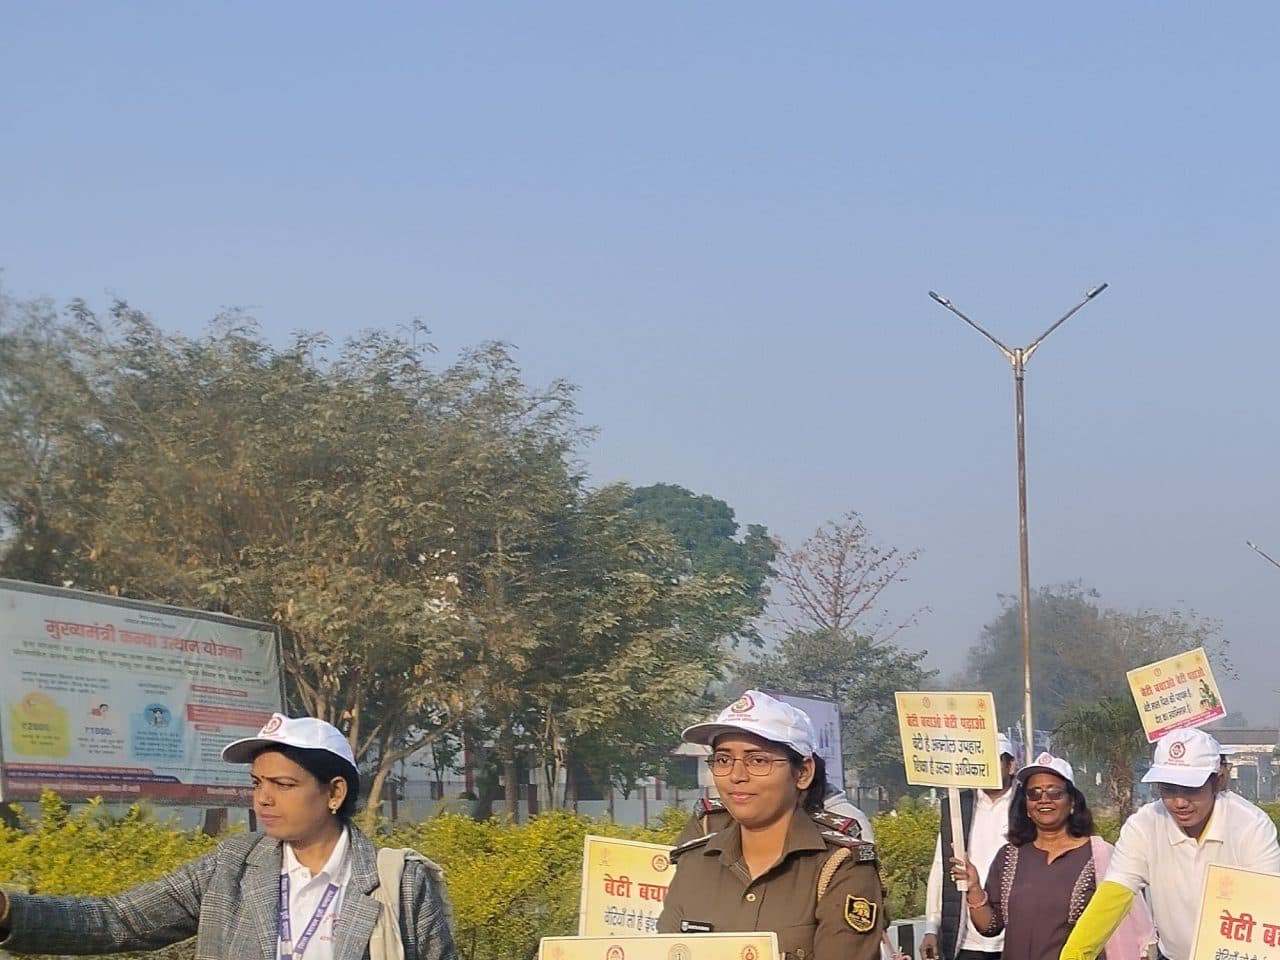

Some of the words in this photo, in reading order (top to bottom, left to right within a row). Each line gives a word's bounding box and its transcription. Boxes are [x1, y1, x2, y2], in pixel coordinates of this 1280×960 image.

[43, 619, 116, 642] मुख्यमंत्री
[603, 874, 633, 898] बेटी
[638, 883, 670, 902] बचा
[1220, 909, 1257, 943] बेटी
